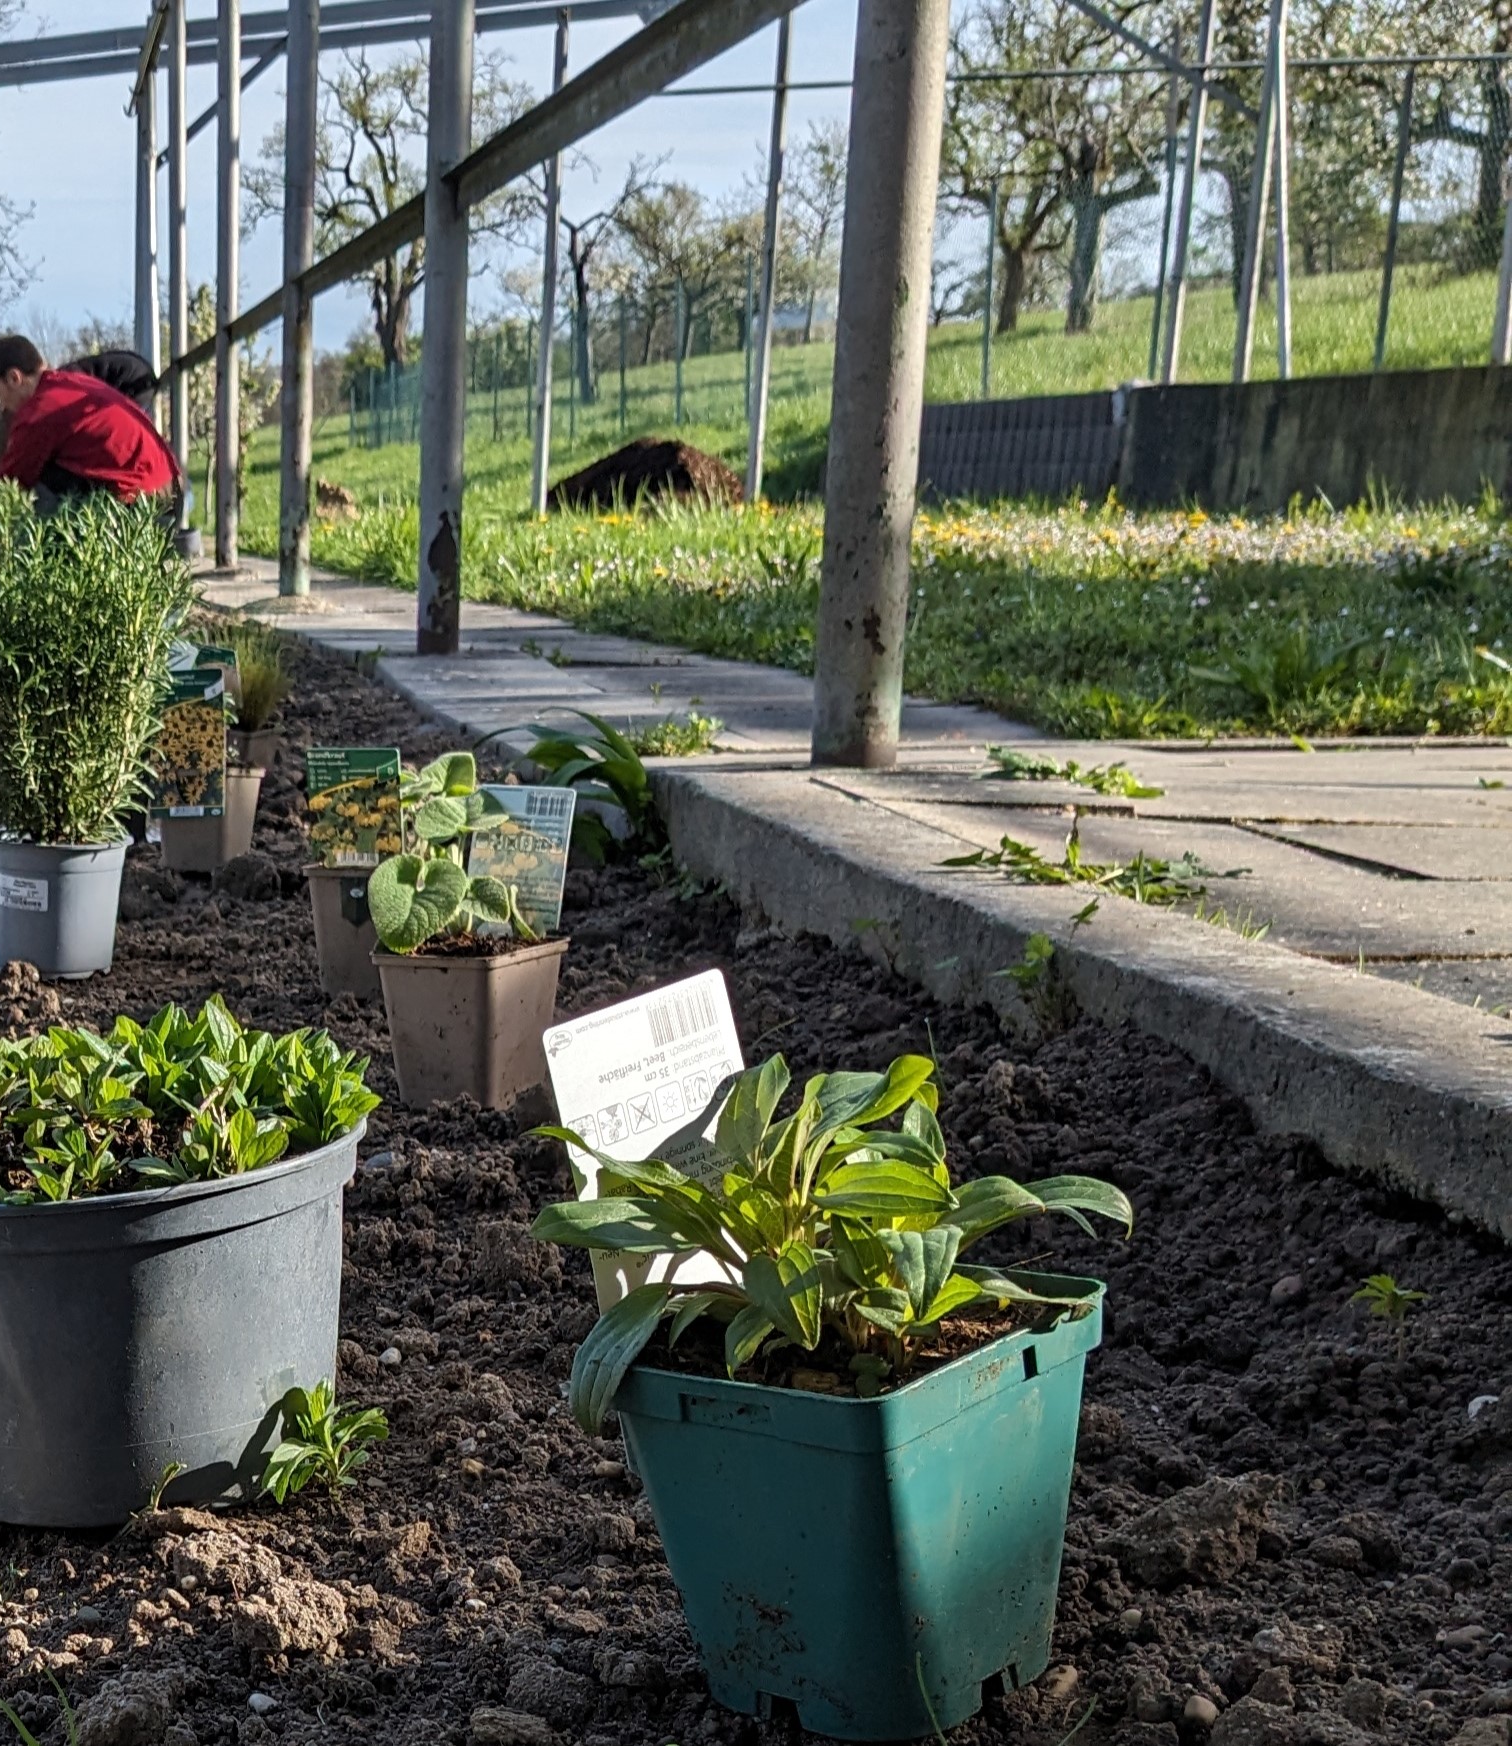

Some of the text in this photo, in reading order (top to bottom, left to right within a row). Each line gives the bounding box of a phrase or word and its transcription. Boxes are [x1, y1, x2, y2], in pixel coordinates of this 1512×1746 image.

[642, 1050, 665, 1068] Beet,
[597, 1059, 642, 1086] Freifläche
[643, 1070, 657, 1082] cm
[657, 1065, 670, 1078] 35
